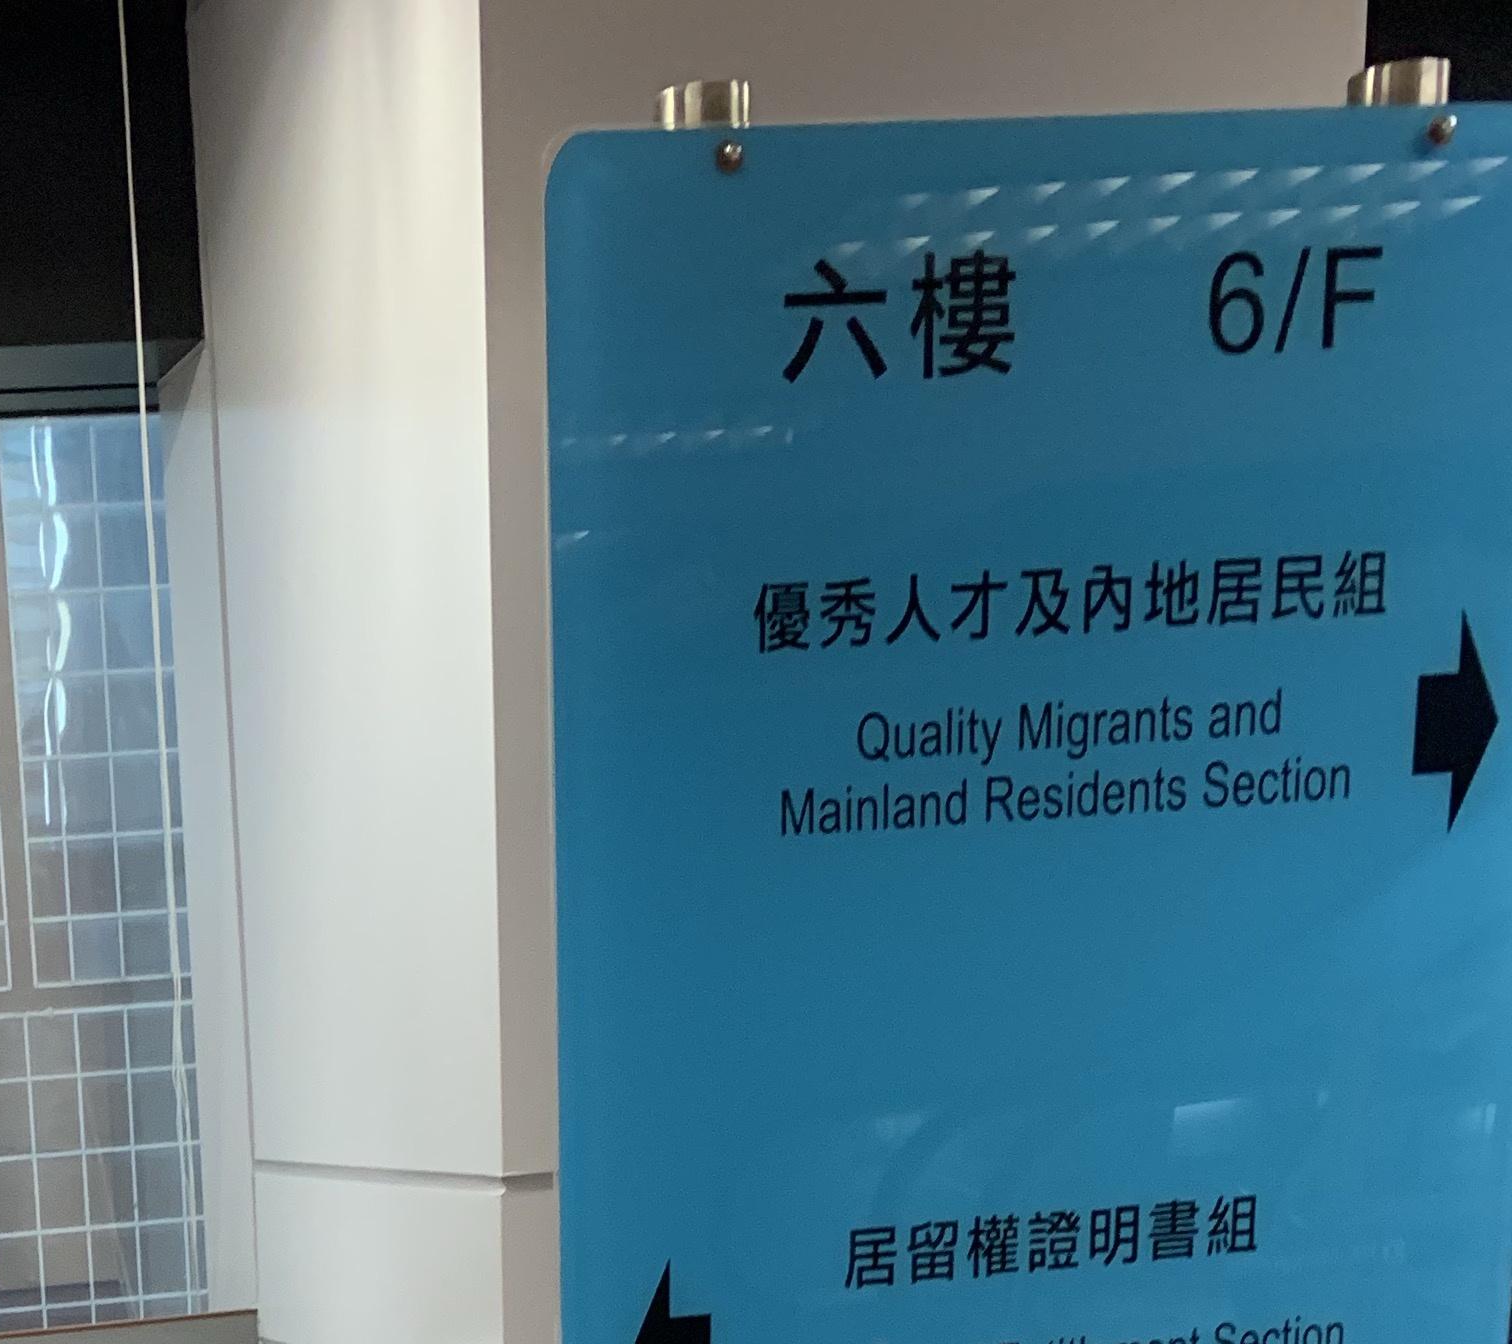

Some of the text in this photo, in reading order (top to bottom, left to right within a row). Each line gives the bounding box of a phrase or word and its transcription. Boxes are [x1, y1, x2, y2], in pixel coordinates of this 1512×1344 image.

[782, 249, 1017, 384] 六樓
[1208, 246, 1383, 355] 6/F
[856, 687, 1284, 766] Quality Migrants and
[779, 756, 1352, 838] Mainland Residents Section
[844, 1194, 1258, 1290] 居留權證明書組
